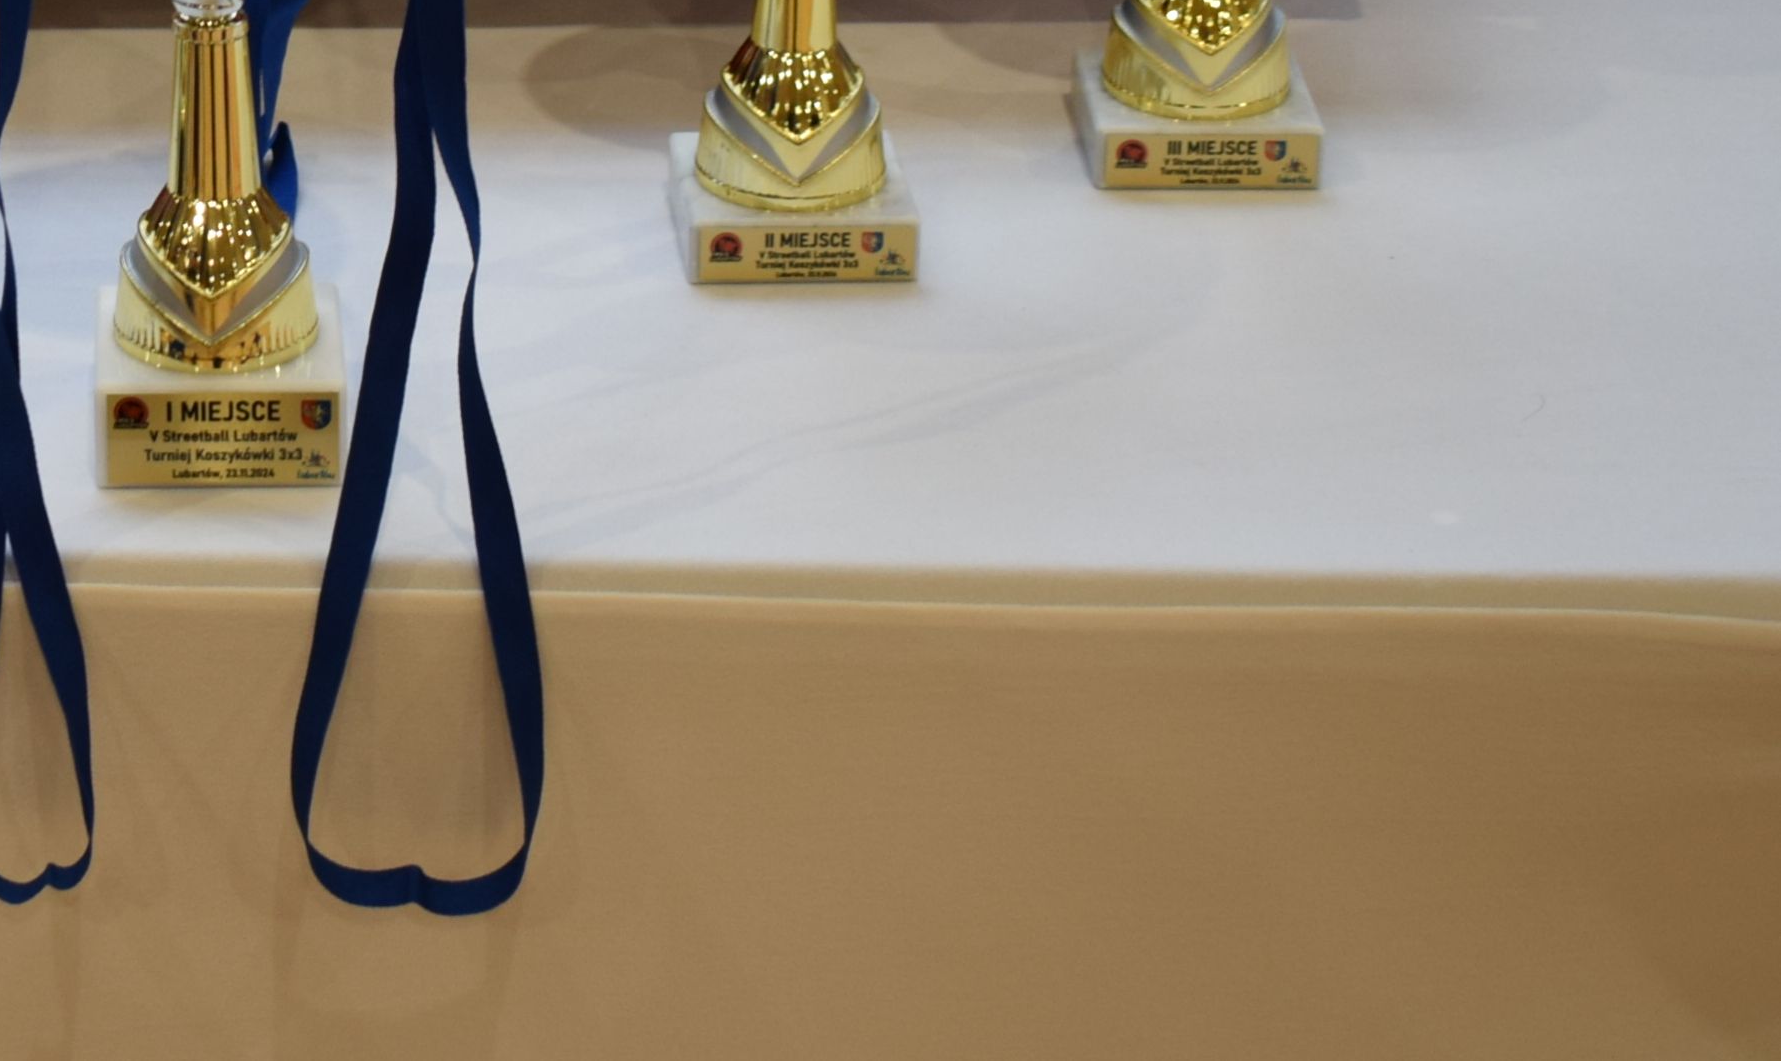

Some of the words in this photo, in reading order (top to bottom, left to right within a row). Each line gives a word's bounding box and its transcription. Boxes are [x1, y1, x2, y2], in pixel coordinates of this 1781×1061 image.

[1187, 140, 1257, 155] MIEJSCE
[765, 233, 774, 248] II
[780, 232, 851, 248] MIEJSCE
[166, 401, 173, 422] I
[181, 400, 281, 422] MIEJSCE
[149, 431, 159, 443] V
[162, 430, 229, 443] Streetball
[233, 429, 298, 443] Lubartów
[144, 449, 191, 464] Turniej
[196, 448, 275, 465] Koszykówki
[279, 448, 303, 461] 3x3
